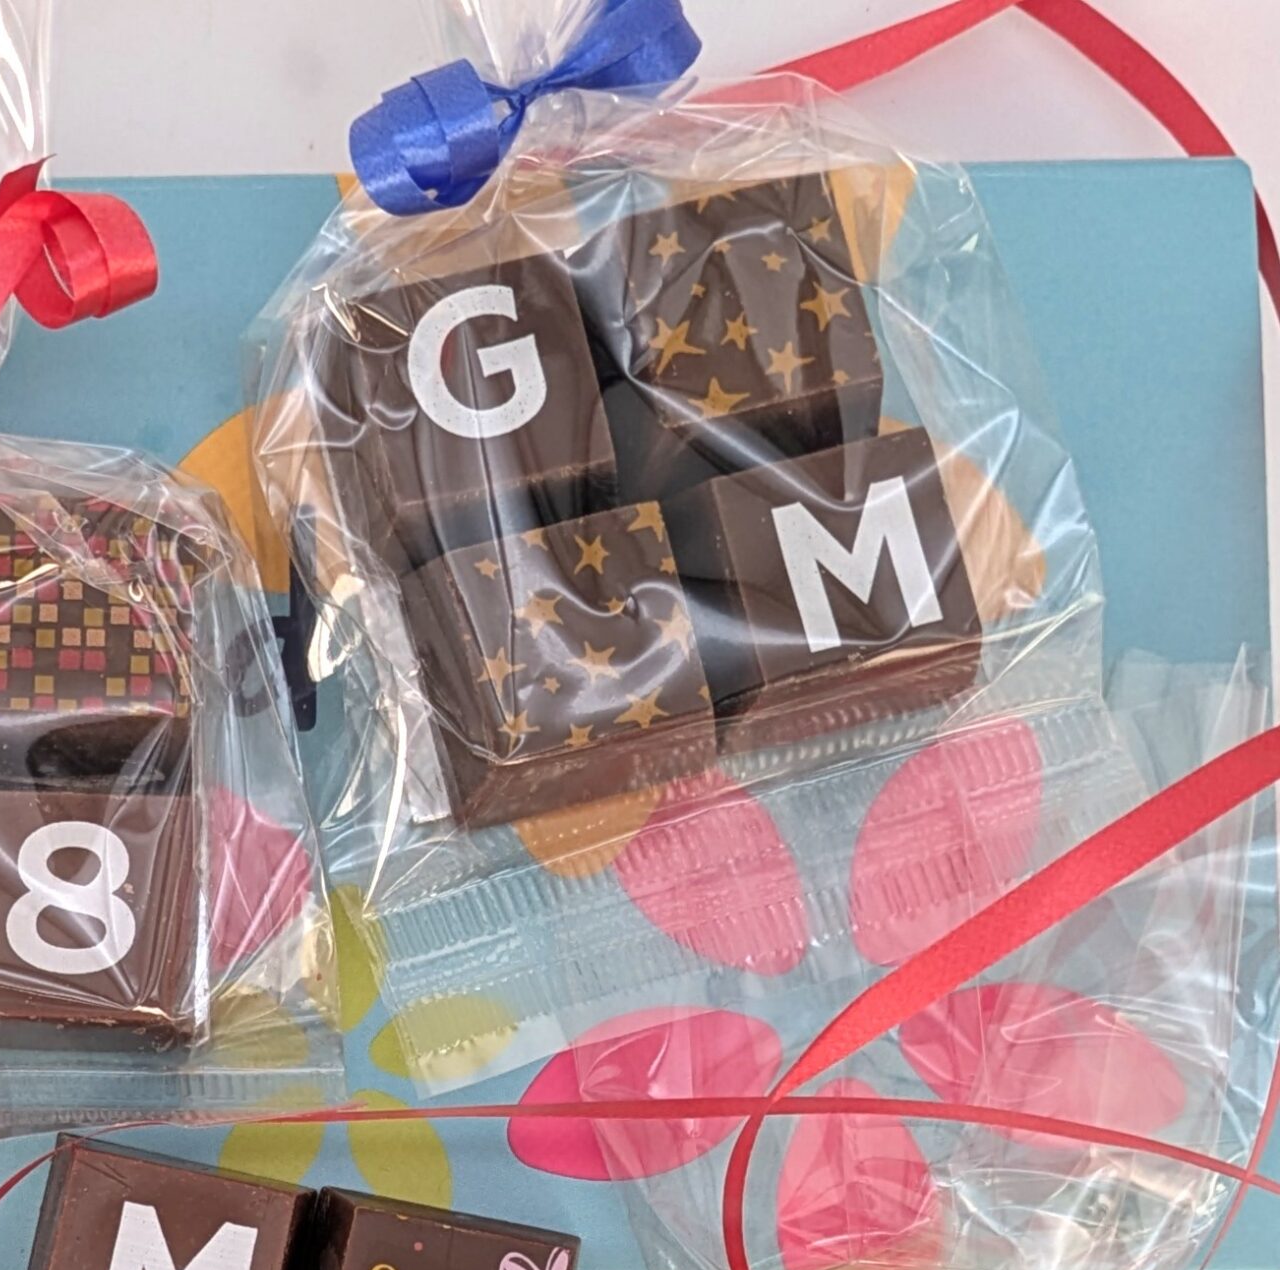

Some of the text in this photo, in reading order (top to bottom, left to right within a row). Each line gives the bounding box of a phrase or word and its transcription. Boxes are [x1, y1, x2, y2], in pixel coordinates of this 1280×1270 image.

[407, 284, 546, 439] G
[772, 477, 943, 652] M
[6, 822, 135, 974] 8
